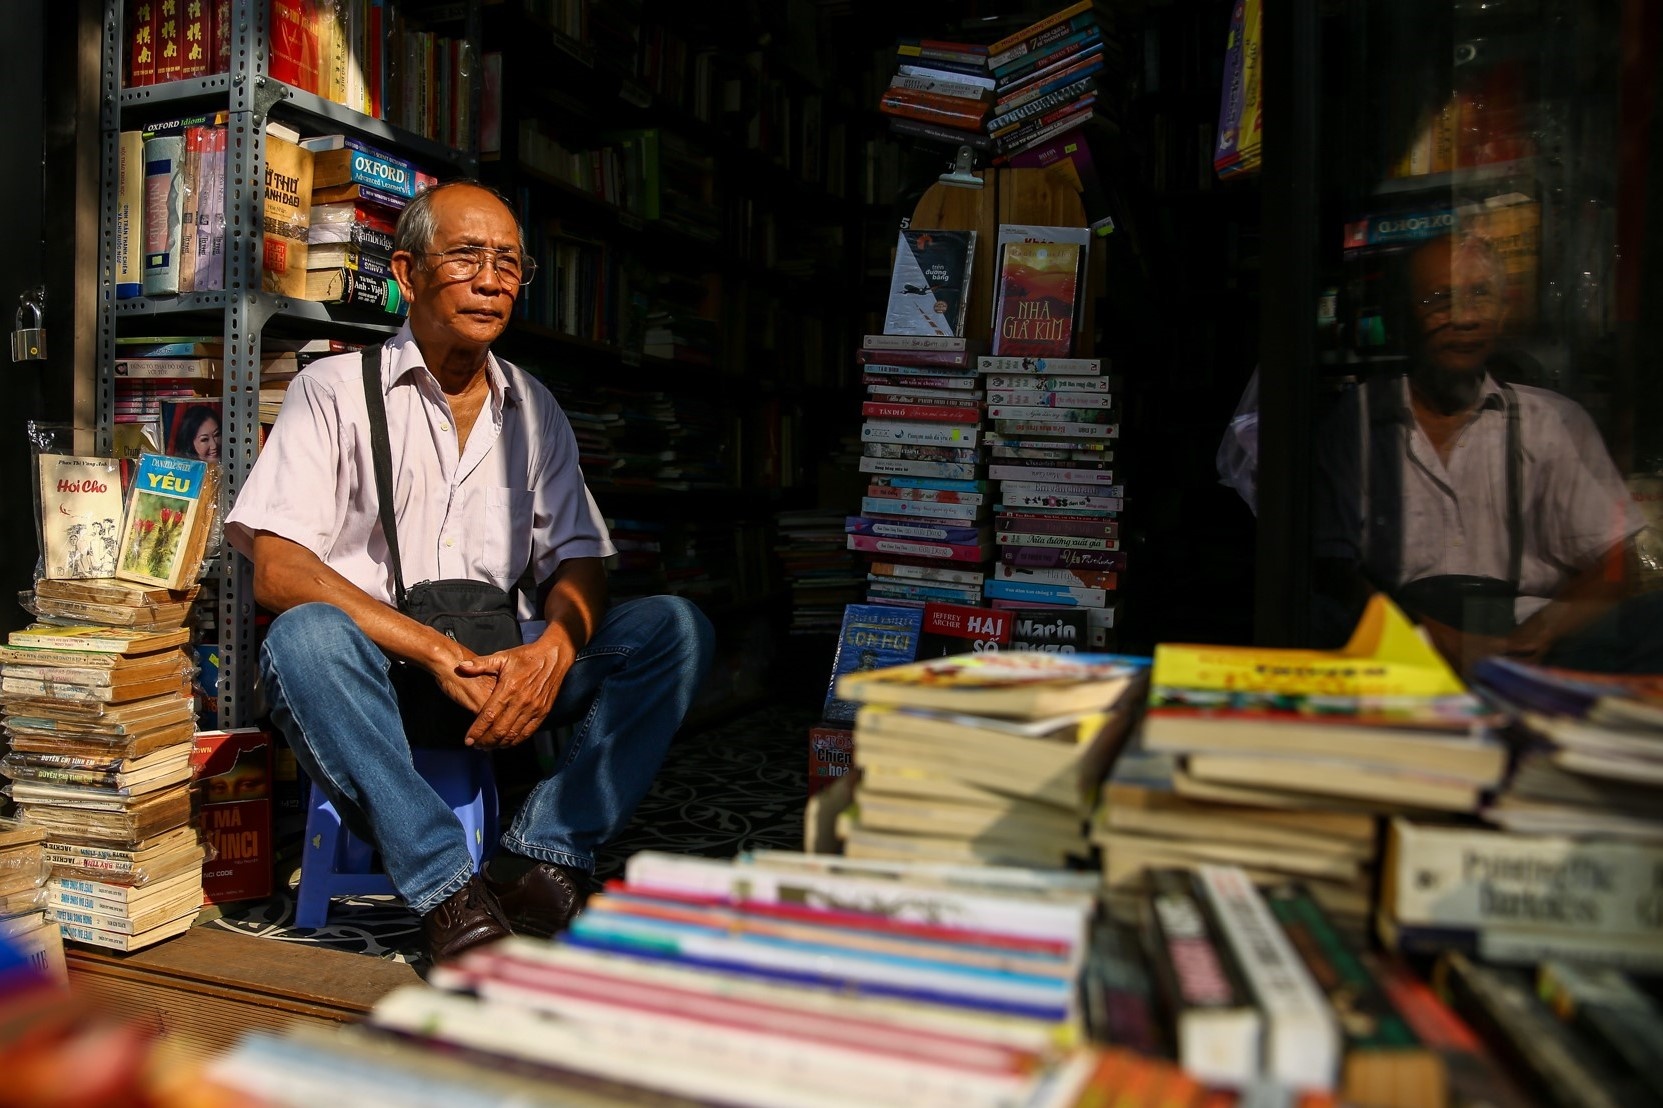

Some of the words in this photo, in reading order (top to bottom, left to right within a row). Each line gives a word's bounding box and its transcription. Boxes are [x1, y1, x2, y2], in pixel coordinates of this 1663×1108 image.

[1030, 37, 1038, 50] 7
[148, 120, 180, 132] OXFORD
[180, 116, 206, 127] Idioms
[355, 156, 405, 183] OXFORD
[355, 172, 384, 186] Advanced
[899, 217, 910, 229] 5
[354, 280, 367, 290] Anh
[371, 284, 383, 295] Việt
[1017, 301, 1050, 320] NHÀ
[1003, 315, 1029, 339] GIẢ
[1034, 318, 1064, 340] KIM
[147, 471, 191, 493] YÊU
[1042, 496, 1068, 507] BOSS
[933, 612, 962, 621] JEFFREY
[932, 619, 961, 629] ARCHER
[967, 616, 1003, 636] HAI
[973, 637, 999, 654] SỐ
[41, 754, 59, 763] DUYÊN
[60, 756, 71, 765] CHỊ
[72, 757, 85, 766] TÌNH
[817, 748, 852, 764] Chiến
[38, 770, 58, 780] DUYÊN
[213, 807, 242, 828] MÃ
[53, 844, 72, 853] JACKIE
[52, 857, 75, 865] JACKIE
[216, 869, 234, 878] CODE
